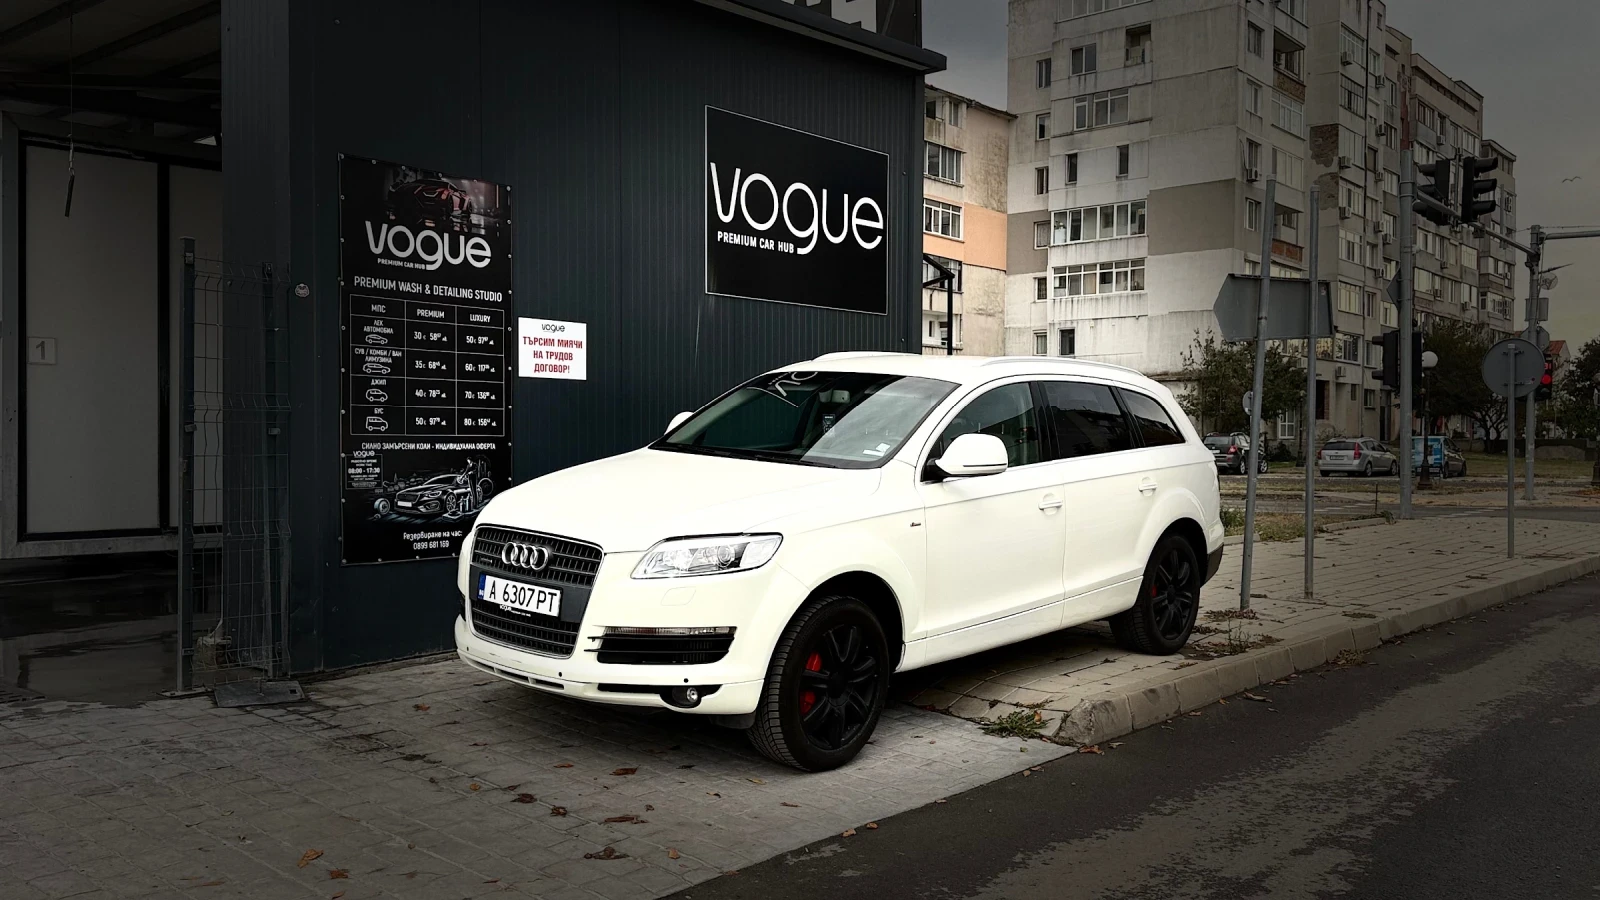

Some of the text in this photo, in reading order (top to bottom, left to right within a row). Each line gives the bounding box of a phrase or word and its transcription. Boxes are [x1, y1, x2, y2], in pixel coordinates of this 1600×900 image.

[710, 162, 884, 255] vogue
[365, 220, 492, 270] vogue
[718, 231, 794, 254] PREMIUM CAR HUB
[377, 258, 403, 267] PREMIUM
[354, 275, 503, 302] PREMIUM WASH & DETAILING STUDIO
[371, 304, 386, 313] МПС
[416, 308, 445, 319] PREMIUM
[469, 313, 491, 323] LUXURY
[363, 326, 394, 334] АВТОМОБИЛ
[541, 323, 565, 333] vogue
[522, 336, 583, 349] ТЪРСИМ МИЯЧИ
[36, 340, 46, 360] 1
[533, 350, 573, 362] НА ТРУДОВ
[534, 363, 570, 374] ДОГОВОР!
[382, 442, 416, 450] ЗАМЪРСЕНИ
[403, 531, 442, 541] Резервиране
[413, 541, 428, 550] 0899
[489, 580, 496, 600] A
